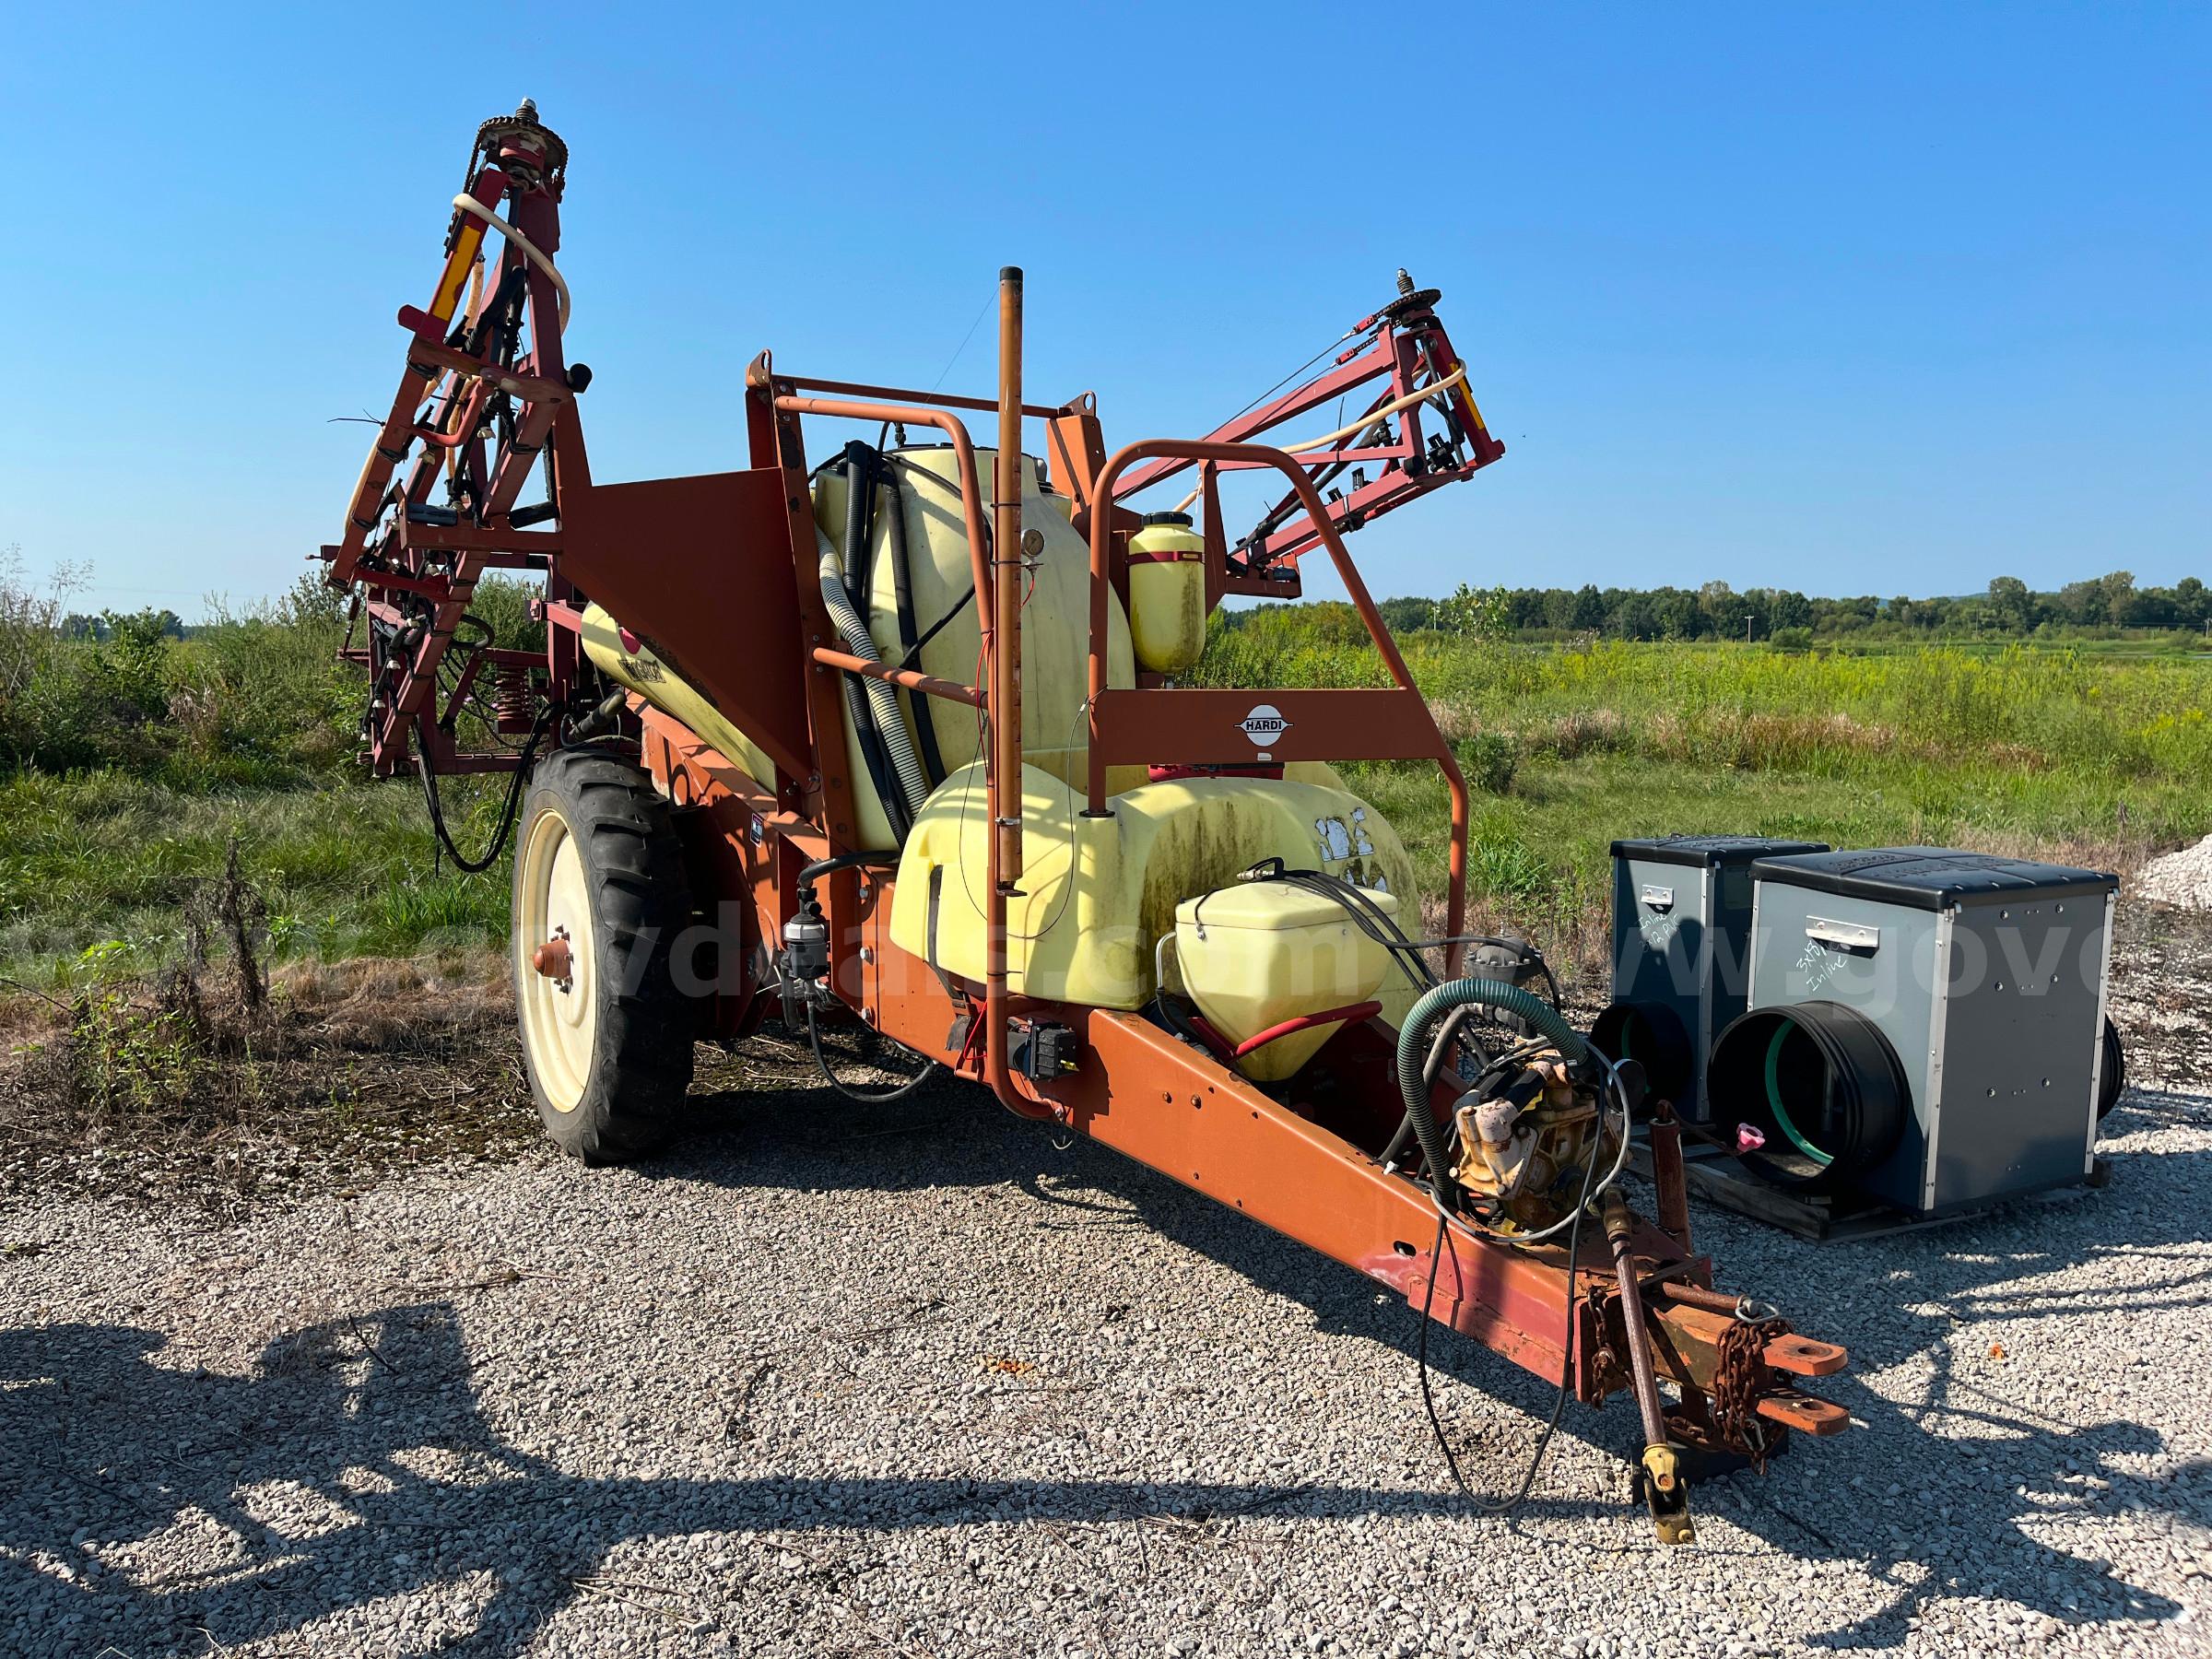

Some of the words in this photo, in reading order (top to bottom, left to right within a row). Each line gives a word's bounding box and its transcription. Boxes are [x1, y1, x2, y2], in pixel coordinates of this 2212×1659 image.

[1246, 720, 1282, 731] HARDI
[1639, 912, 1667, 930] Inline
[1806, 955, 1847, 992] Inline
